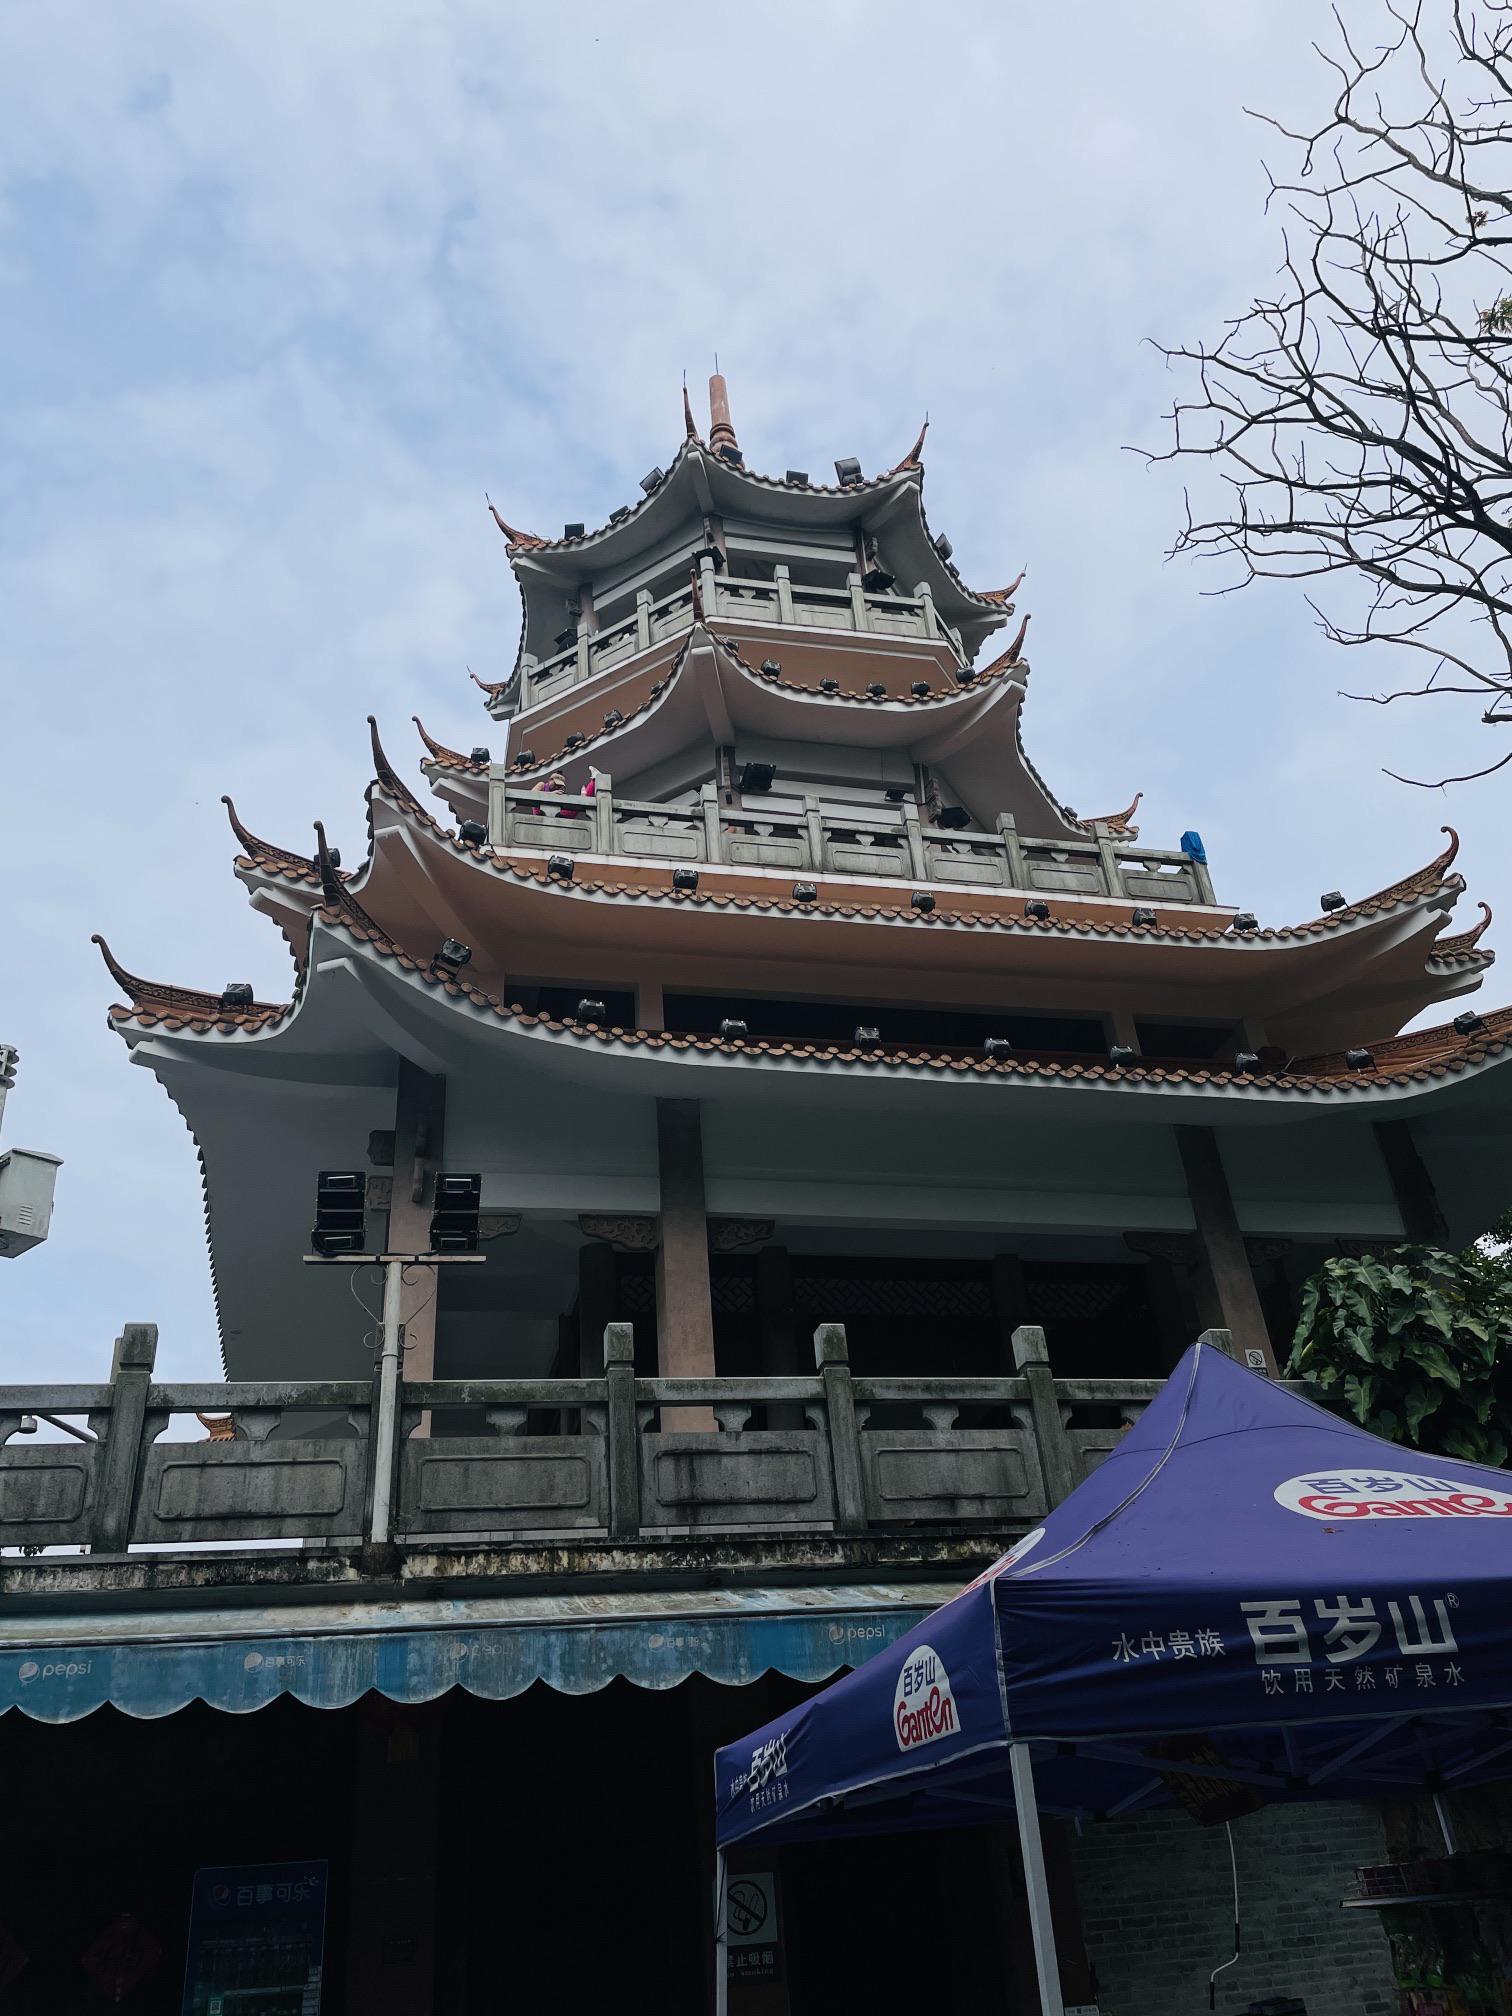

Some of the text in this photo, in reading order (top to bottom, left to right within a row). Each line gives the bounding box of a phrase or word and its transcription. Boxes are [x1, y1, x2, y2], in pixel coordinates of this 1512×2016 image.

[1299, 1476, 1462, 1494] 百岁山
[847, 1624, 886, 1641] pepsi
[1111, 1627, 1227, 1663] 水中贵族
[42, 1660, 92, 1681] pepsi
[903, 1656, 936, 1698] 百岁山
[1260, 1661, 1465, 1695] 饮用天然矿泉水
[897, 1686, 954, 1746] Ganten
